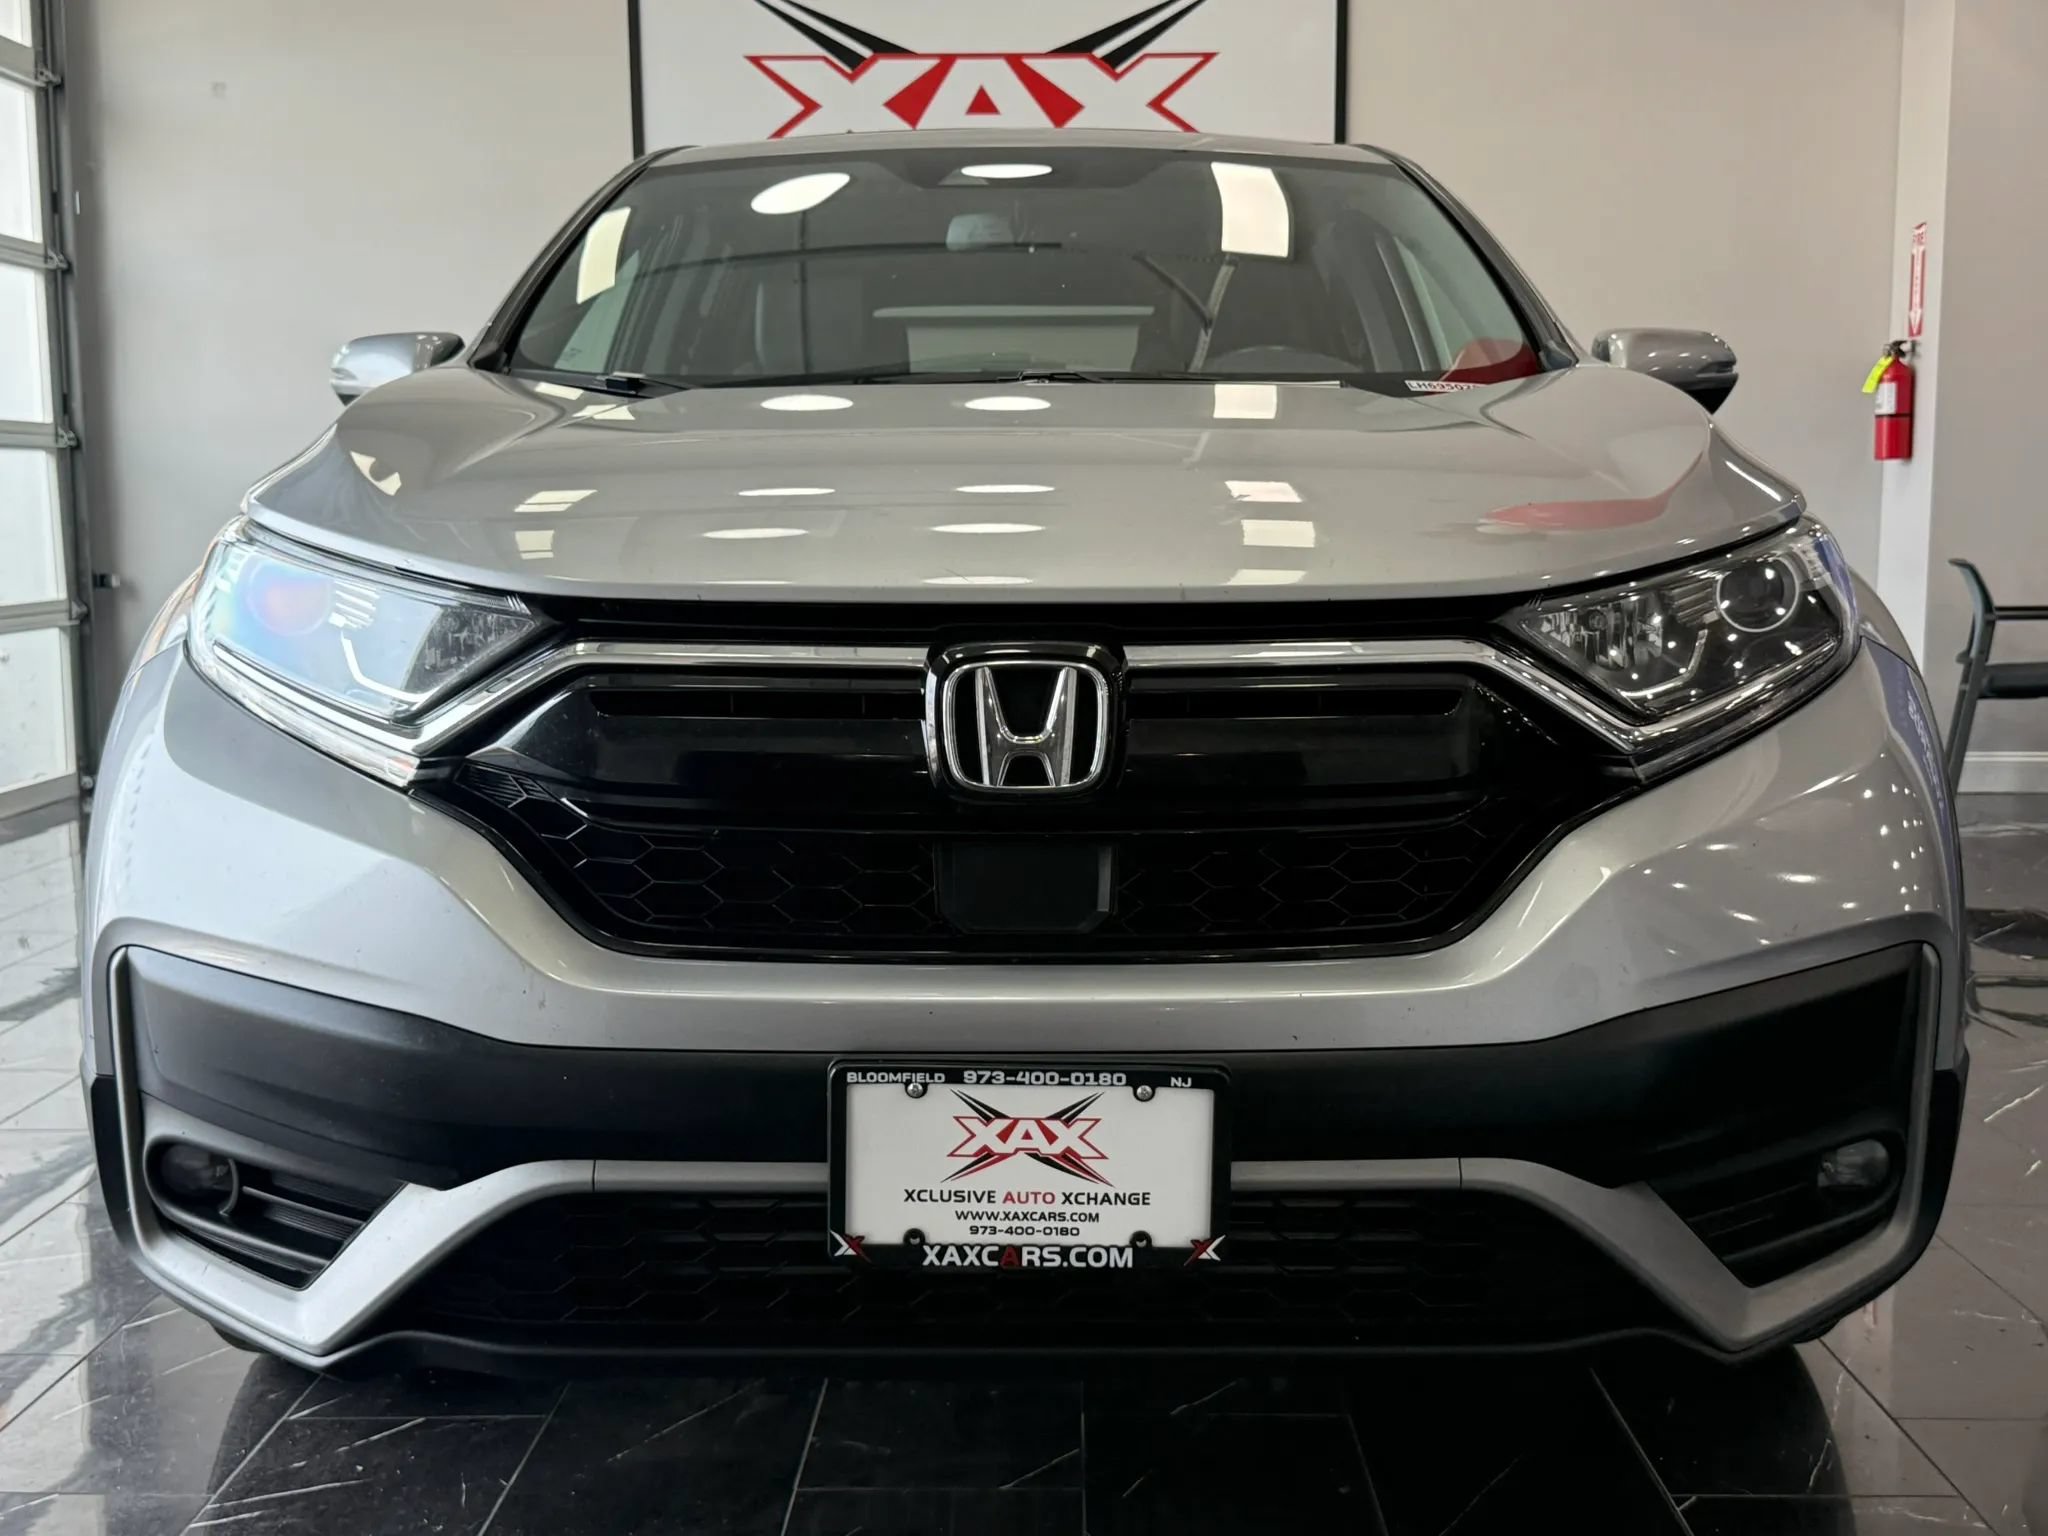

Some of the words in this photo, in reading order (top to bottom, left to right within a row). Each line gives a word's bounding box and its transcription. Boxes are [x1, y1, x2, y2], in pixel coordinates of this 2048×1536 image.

[743, 52, 1220, 139] XAX
[846, 1071, 946, 1084] BLOOMFIELD
[963, 1070, 1127, 1086] 973-400-0180
[1170, 1076, 1193, 1088] NJ
[947, 1115, 1109, 1159] XAX
[904, 1188, 997, 1204] XCLUSIVE
[1002, 1191, 1056, 1205] AUTO
[1061, 1192, 1151, 1206] XCHANGE
[955, 1210, 1100, 1223] WWW.XAXCARS.COM
[969, 1225, 1080, 1237] 973-400-0180
[922, 1245, 1134, 1269] XAXCARS.COM
